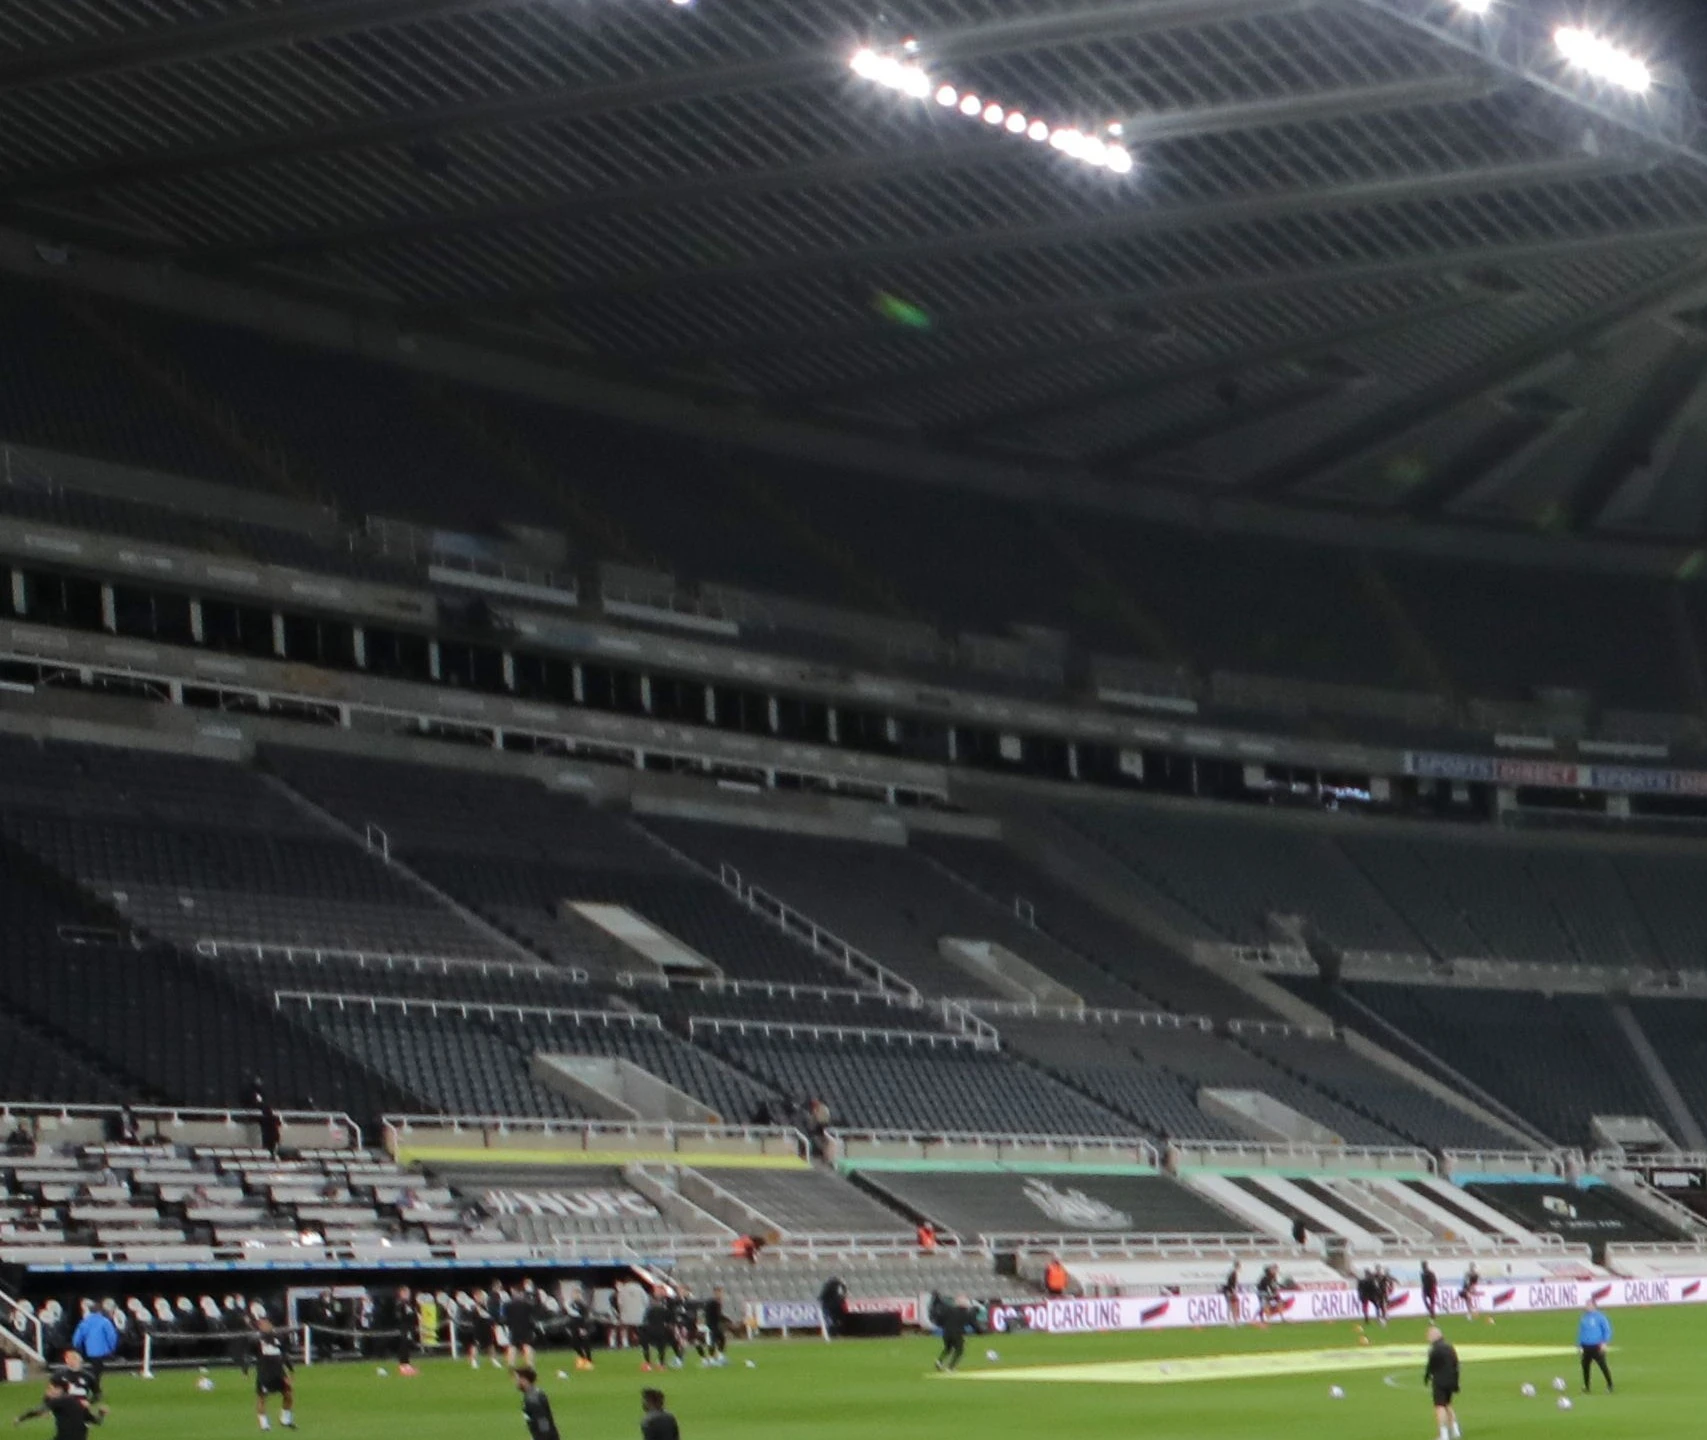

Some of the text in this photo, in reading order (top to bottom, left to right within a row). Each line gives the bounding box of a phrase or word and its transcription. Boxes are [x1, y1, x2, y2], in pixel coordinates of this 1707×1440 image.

[1529, 1285, 1578, 1306] CARLING
[1624, 1281, 1669, 1302] CARLING
[1051, 1301, 1122, 1329] CARLING
[1312, 1293, 1363, 1317] CARLIN
